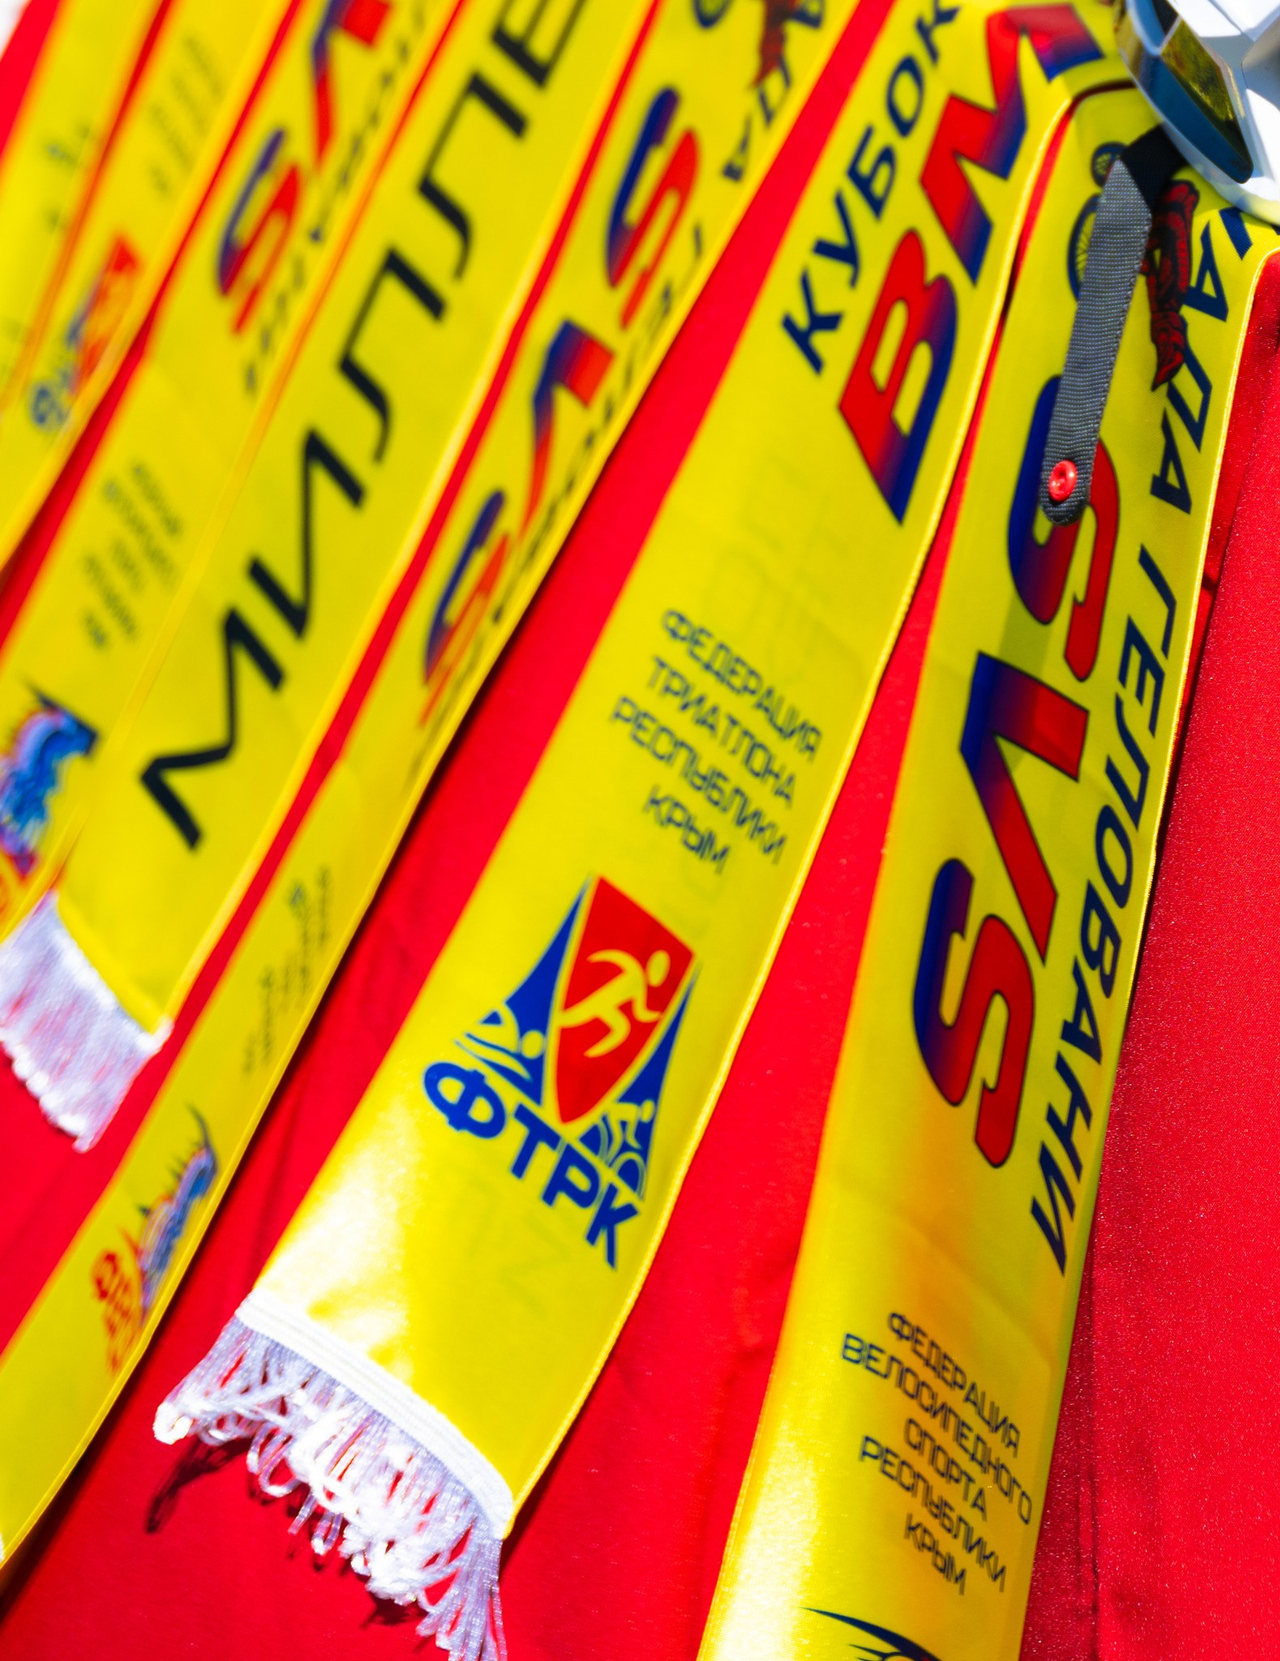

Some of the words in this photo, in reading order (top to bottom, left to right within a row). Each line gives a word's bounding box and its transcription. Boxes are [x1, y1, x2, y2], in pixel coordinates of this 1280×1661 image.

[645, 655, 797, 810] ТРИАТЛОНА
[660, 607, 823, 764] ФЕДЕРАЦИЯ
[609, 694, 789, 866] РЕСПУБЛИКИ
[642, 785, 732, 875] КРЫМ
[1031, 543, 1176, 1275] ГЕЛОВАНИ
[421, 1058, 643, 1271] ФТРК
[841, 1333, 1033, 1526] ВЕЛОСИПЕДНОГО
[887, 1311, 1021, 1459] ФЕДЕРАЦИЯ
[859, 1435, 1007, 1593] РЕСПУБЛИКИ
[904, 1416, 989, 1521] СПОРТА
[904, 1513, 969, 1596] КРЫМ
